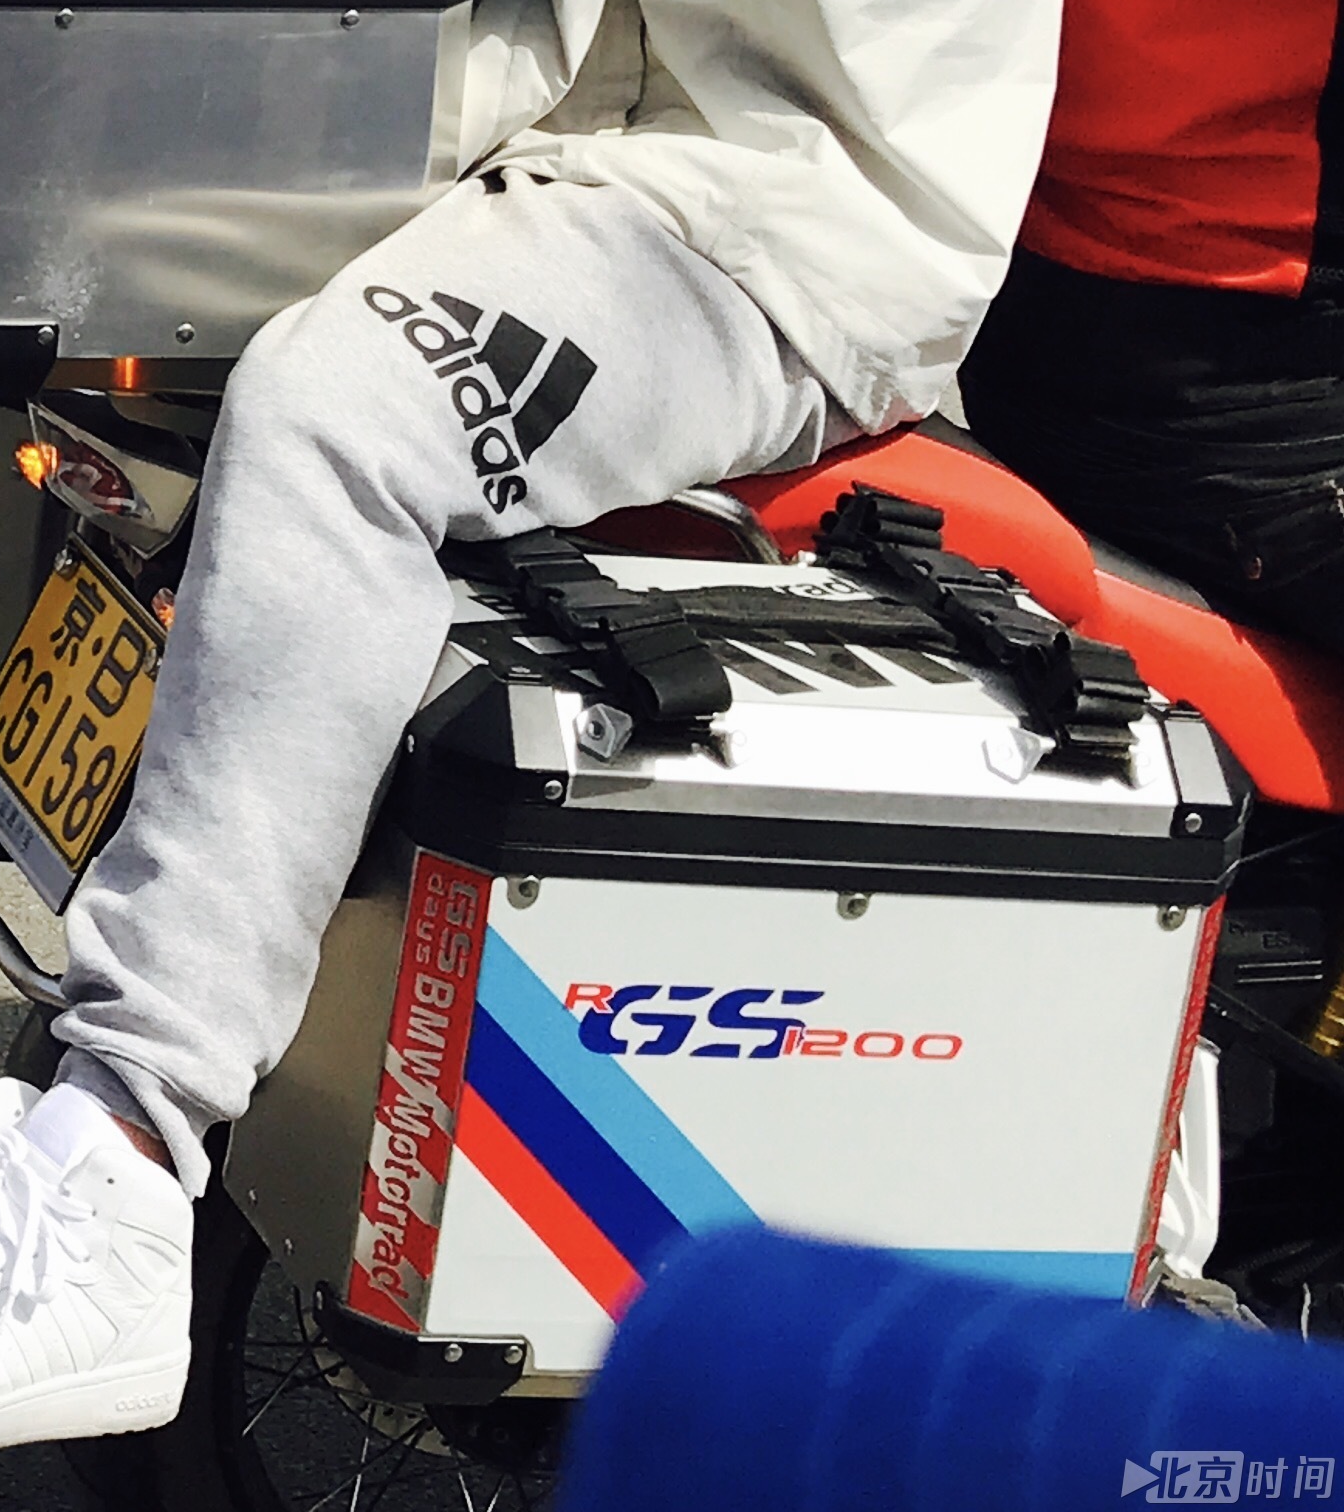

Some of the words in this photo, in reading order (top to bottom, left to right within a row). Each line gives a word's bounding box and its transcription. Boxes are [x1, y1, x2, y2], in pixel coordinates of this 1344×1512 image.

[363, 285, 528, 515] adidas
[403, 972, 455, 1094] BMW
[372, 1092, 431, 1300] Motorrad
